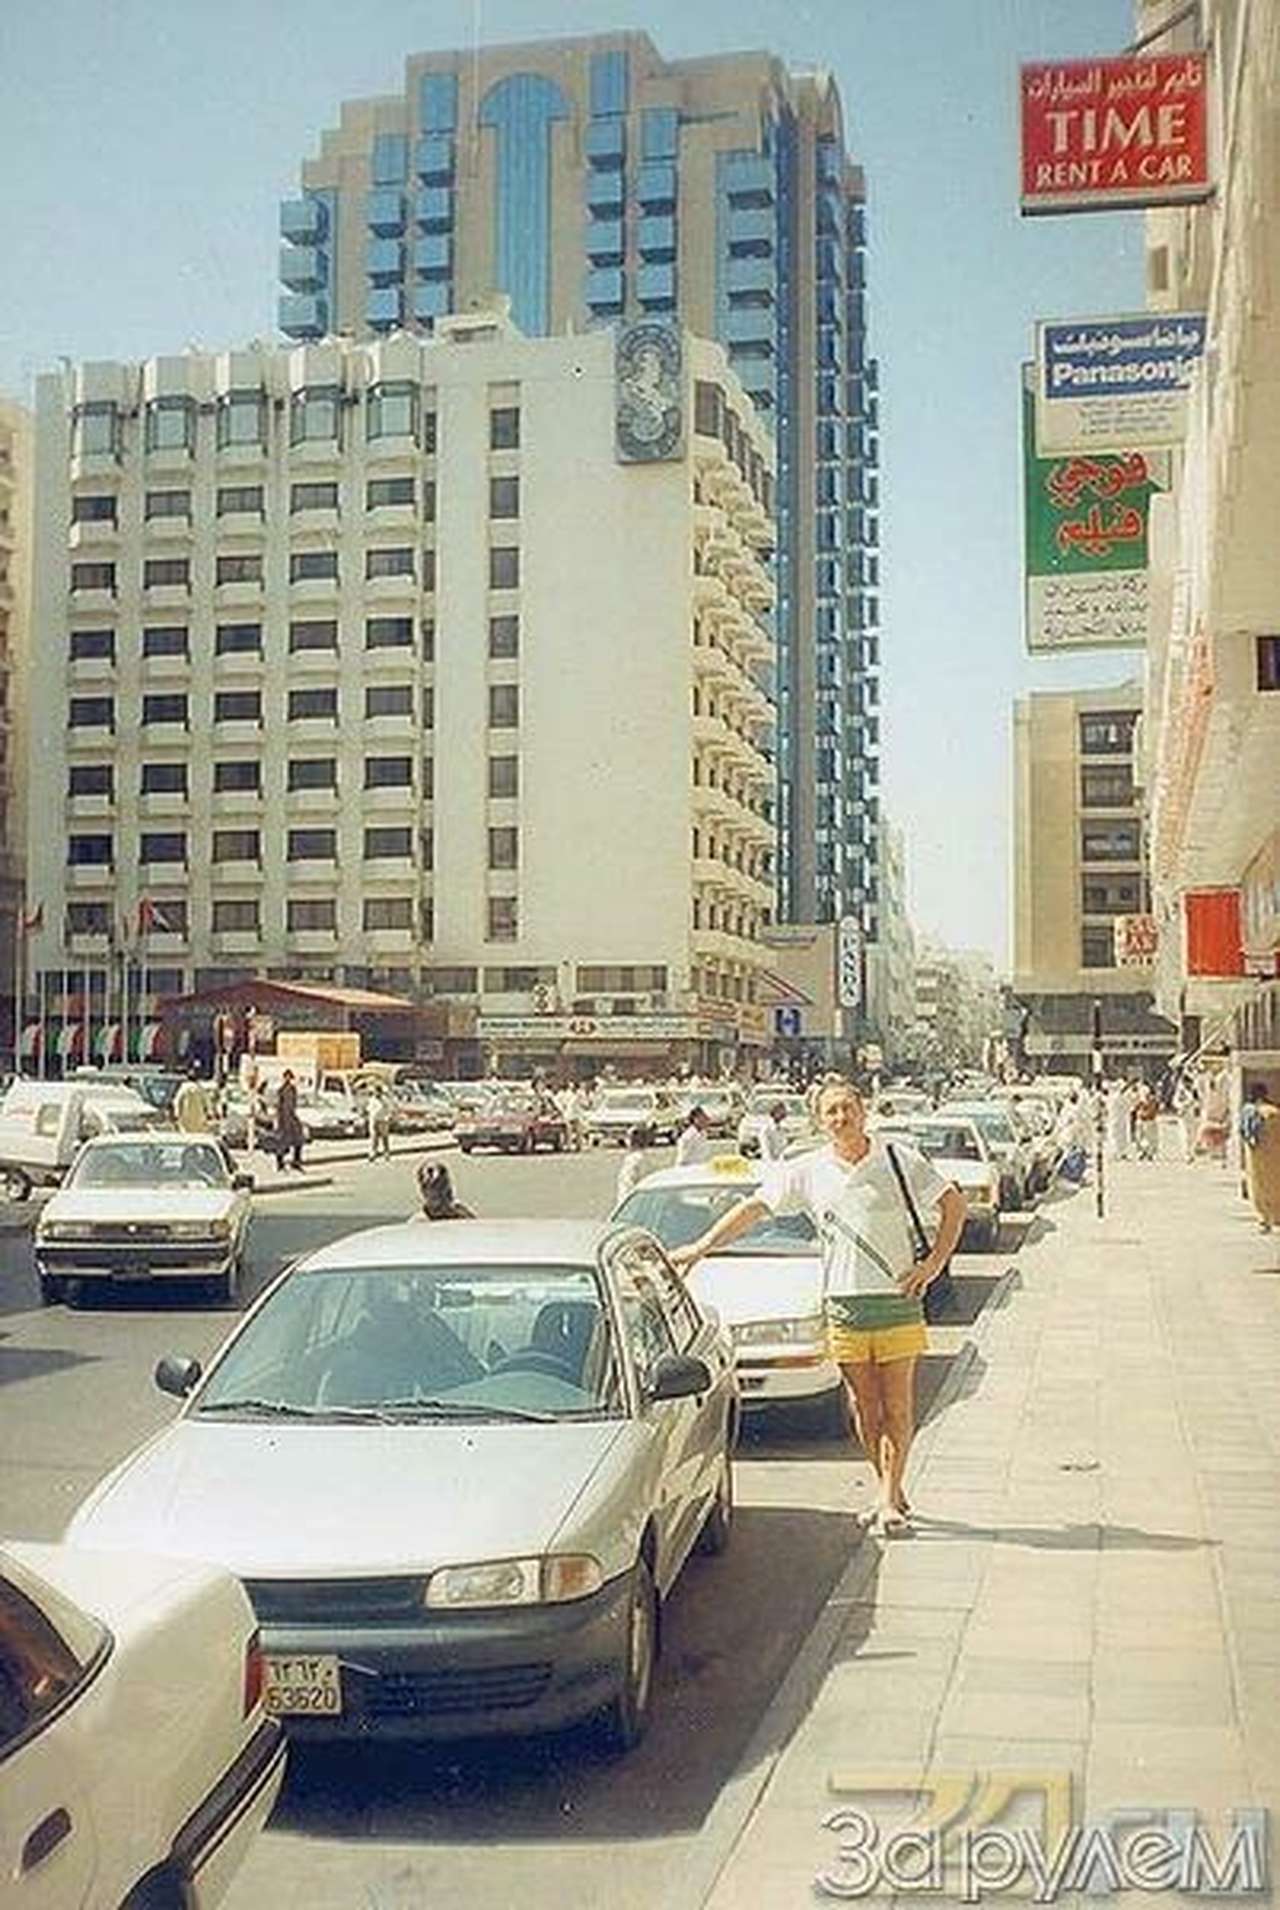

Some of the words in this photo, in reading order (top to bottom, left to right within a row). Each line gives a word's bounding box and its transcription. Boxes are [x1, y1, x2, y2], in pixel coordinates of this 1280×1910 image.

[1045, 104, 1187, 153] TIME
[1036, 159, 1102, 188] RENT
[1109, 161, 1129, 181] A
[1138, 154, 1193, 180] CAR
[1053, 355, 1199, 387] Panasonic
